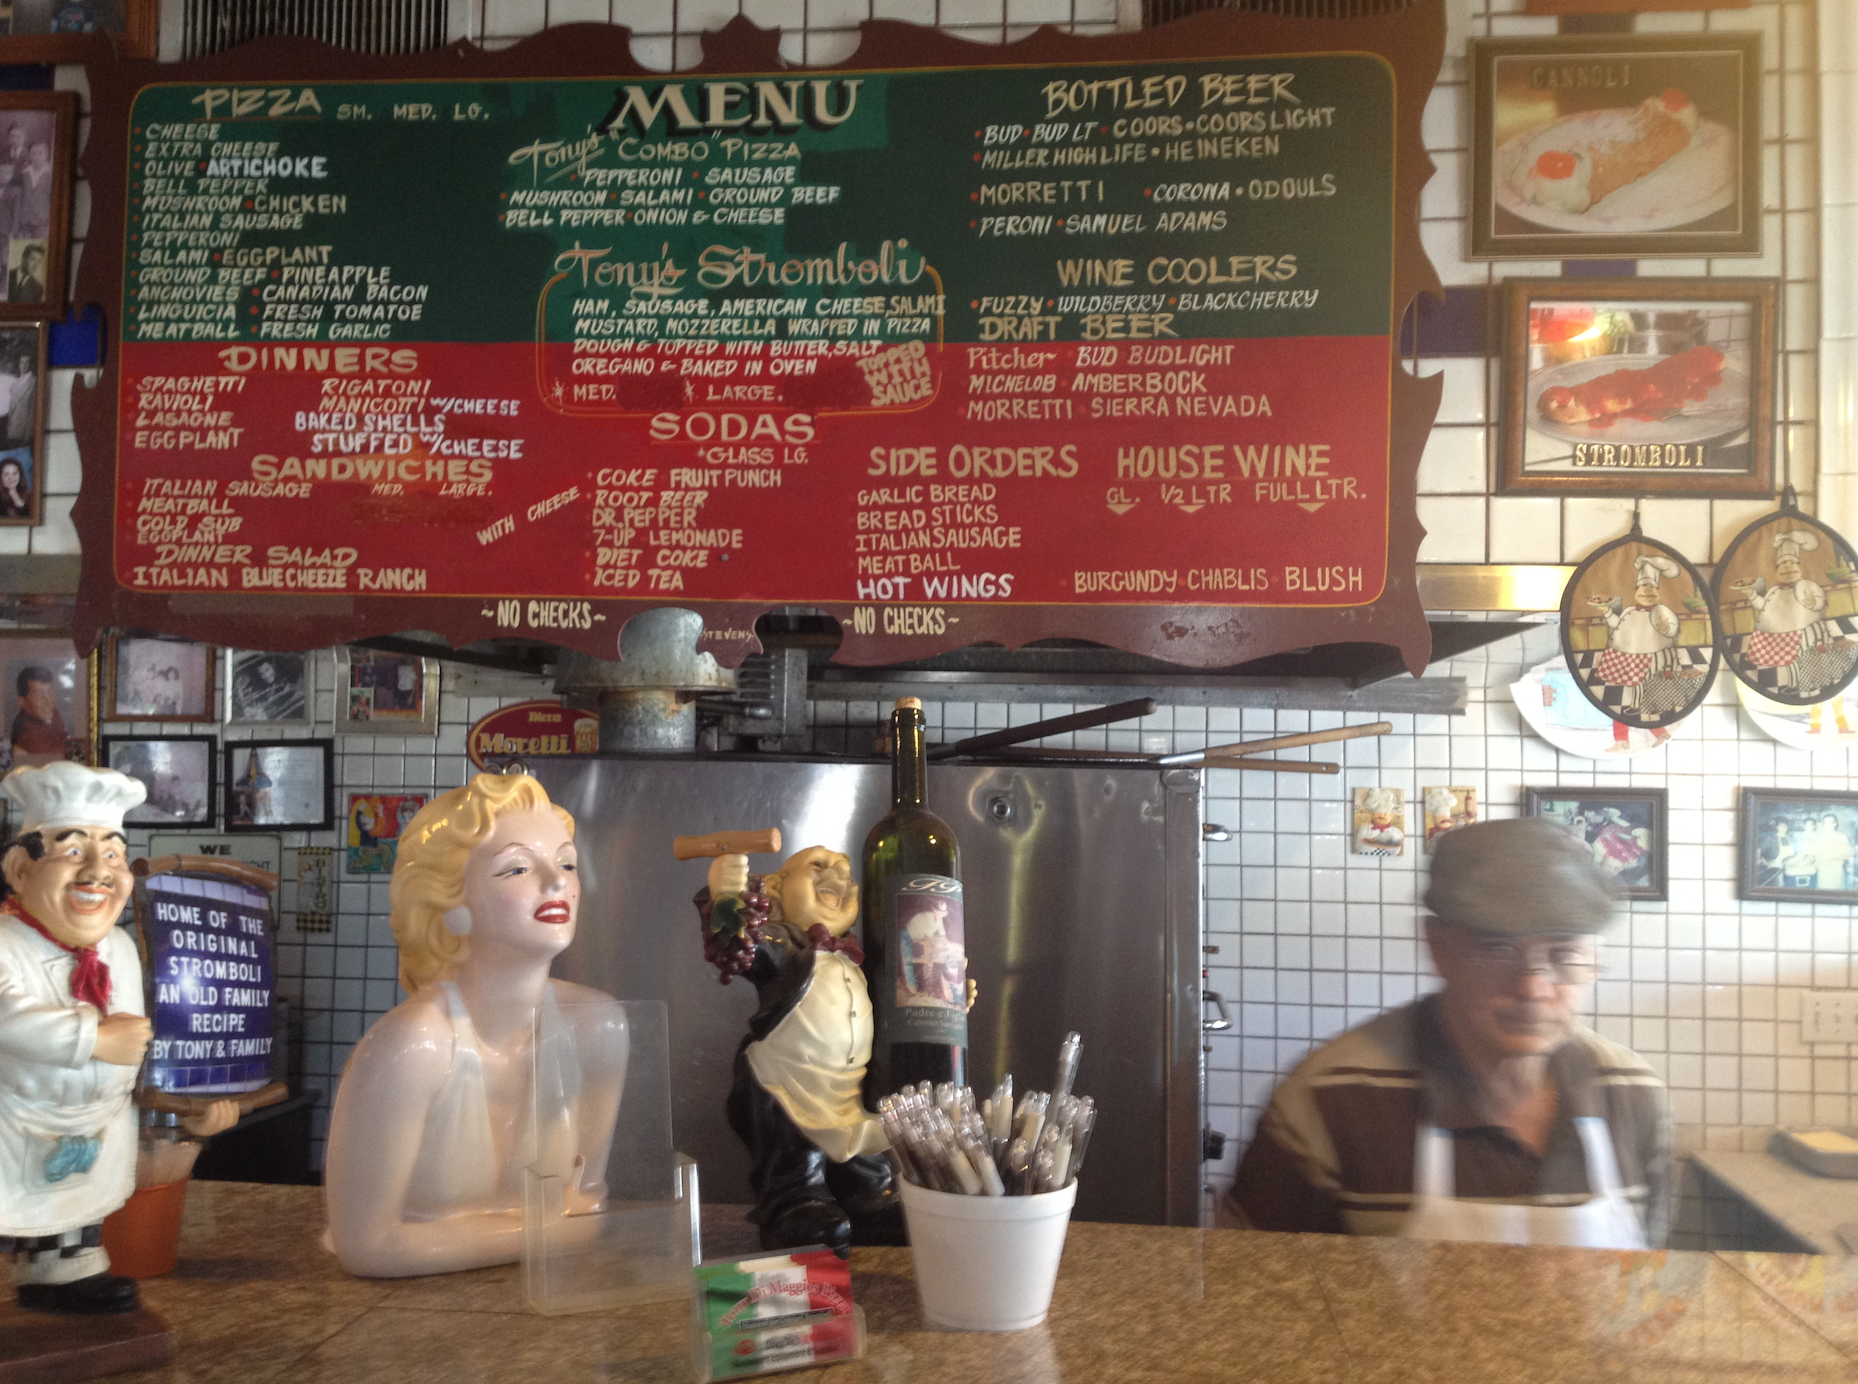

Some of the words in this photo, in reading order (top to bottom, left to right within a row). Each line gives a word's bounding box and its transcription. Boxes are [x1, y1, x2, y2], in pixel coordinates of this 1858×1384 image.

[1532, 64, 1630, 89] CANNOLI
[192, 88, 322, 120] PIZZA
[337, 103, 372, 121] SM.
[393, 103, 437, 121] MED.
[453, 103, 489, 121] LG.
[609, 79, 864, 131] MENU
[1040, 76, 1187, 119] BOTTLED
[1199, 73, 1300, 109] BEER
[983, 124, 1023, 146] BUD
[1031, 122, 1069, 144] BUD
[1072, 121, 1099, 142] LT
[1113, 115, 1184, 138] COORS
[145, 142, 202, 158] EXTRA
[210, 142, 280, 157] CHEESE
[508, 124, 605, 189] Tony's
[720, 138, 801, 161] PIZZA
[981, 148, 1050, 170] MILLER
[1053, 146, 1097, 166] HIGH
[1100, 143, 1147, 165] LIFE
[1165, 135, 1279, 161] HEINEKEN
[145, 160, 195, 177] OLIVE
[206, 156, 328, 178] ARTICHOKE
[583, 167, 683, 188] PEPPERONI
[705, 166, 796, 185] SAUSAGE
[143, 178, 187, 195] BELL
[197, 178, 269, 195] PEPPER
[509, 190, 608, 208] MUSHROOM
[620, 188, 694, 206] SALAMI
[709, 186, 785, 205] GROUND
[791, 186, 841, 205] BEEF
[1153, 181, 1230, 203] CORONA
[142, 195, 243, 212] MUSHROOM
[254, 194, 346, 214] CHICKEN
[142, 213, 213, 230] ITALIAN
[219, 213, 304, 230] SAUSAGE
[505, 209, 554, 229] BELL
[560, 209, 625, 227] PEPPER
[634, 208, 689, 226] ONION
[713, 207, 785, 225] CHEESE
[979, 215, 1052, 238] PERONI
[1065, 214, 1147, 236] SAMUEL
[1155, 210, 1228, 233] ADAMS
[141, 231, 240, 248] PEPPERONI
[139, 249, 209, 265] SALAMI
[222, 245, 333, 266] EGGPLANT
[139, 268, 211, 284] GROUND
[218, 268, 268, 285] BEEF
[282, 265, 391, 285] PINEAPPLE
[554, 241, 687, 301] Tony's
[698, 239, 926, 289] Stromboli
[1056, 258, 1136, 289] WINE
[1147, 254, 1298, 286] COOLERS
[138, 286, 240, 302] ANCHOVIES
[262, 284, 355, 302] CANADIAN
[367, 284, 429, 302] BACON
[138, 304, 236, 320] LINGUICIA
[262, 304, 324, 321] FRESH
[334, 304, 423, 321] TOMATOE
[719, 297, 807, 317] AMERICAN
[979, 295, 1044, 316] FUZZY
[1057, 294, 1165, 314] WILDBERRY
[137, 322, 240, 340] MEATBALL
[260, 321, 320, 340] FRESH
[328, 322, 391, 340] GARLIC
[788, 318, 858, 336] WRAPPED
[863, 318, 881, 336] IN
[887, 318, 931, 334] PIZZA
[978, 316, 1063, 341] DRAFT
[1080, 312, 1180, 341] BEER
[573, 338, 634, 354] DOUGH
[657, 338, 719, 355] TOPPED
[725, 340, 764, 356] WITH
[856, 339, 926, 373] TOPPED
[1075, 346, 1118, 367] BUD
[218, 346, 418, 372] DINNERS
[572, 358, 655, 376] OREGANO
[680, 358, 738, 377] BAKED
[744, 359, 763, 376] IN
[770, 358, 817, 376] OVEN
[136, 375, 247, 393] SPAGHETTI
[864, 357, 931, 389] WITH
[968, 374, 1056, 394] MICHELOB
[321, 378, 432, 396] RIGATONI
[871, 376, 933, 406] SAUCE
[138, 393, 214, 412] RAVIOLI
[319, 396, 425, 414] MANICOTTI
[967, 398, 1073, 421] MORRETTI
[1091, 396, 1170, 418] SIERRA
[1177, 395, 1273, 418] NEVADA
[135, 411, 234, 428] LASAGNE
[295, 411, 357, 431] BAKED
[363, 413, 446, 433] SHELLS
[649, 412, 816, 444] SODAS
[134, 428, 244, 450] EGGPLANT
[311, 432, 412, 454] STUFFED
[706, 447, 774, 464] GLASS
[867, 446, 937, 477] SIDE
[949, 444, 1079, 479] ORDERS
[1117, 445, 1224, 479] HOUSE
[1233, 444, 1331, 479] WINE
[1575, 444, 1705, 467] STROMBOLI
[251, 453, 493, 484] SANDWICHES
[597, 468, 658, 487] COKE
[670, 468, 722, 488] FRUIT
[725, 469, 782, 488] PUNCH
[143, 477, 217, 496] ITALIAN
[225, 481, 312, 498] SAUSAGE
[858, 485, 924, 506] GARLIC
[930, 483, 997, 502] BREAD
[138, 497, 235, 515] MEATBALL
[595, 490, 654, 508] ROOT
[660, 490, 709, 508] BEER
[137, 515, 188, 532] COLD
[198, 516, 243, 534] SUB
[476, 514, 515, 546] WITH
[527, 486, 581, 522] CHEESE
[857, 510, 926, 531] BREAD
[932, 504, 999, 526] STICKS
[592, 530, 636, 547] 7-UP
[650, 529, 743, 548] LEMONADE
[154, 544, 253, 566] DINNER
[267, 545, 358, 567] SALAD
[596, 548, 643, 567] DIET
[657, 549, 710, 567] COKE
[133, 566, 228, 588] ITALIAN
[357, 567, 427, 591] RANCH
[594, 567, 640, 588] ICED
[648, 569, 684, 590] TEA
[857, 576, 912, 600] HOT
[923, 572, 1014, 600] WINGS
[1075, 569, 1177, 593] BURGUNDY
[1187, 568, 1269, 590] CHABLIS
[1285, 566, 1363, 592] BLUSH
[478, 733, 571, 755] Moretti
[199, 845, 232, 855] WE
[156, 902, 202, 925] HOME
[208, 910, 228, 929] OF
[239, 915, 264, 935] THE
[173, 930, 258, 959] ORIGINAL
[170, 956, 261, 982] STROMBOLI
[158, 984, 180, 1004] AN
[189, 986, 218, 1005] OLD
[224, 988, 270, 1007] FAMILY
[192, 1012, 246, 1032] RECIPE
[153, 1039, 170, 1060] BY
[176, 1040, 214, 1059] TONY
[230, 1037, 273, 1057] FAMILY
